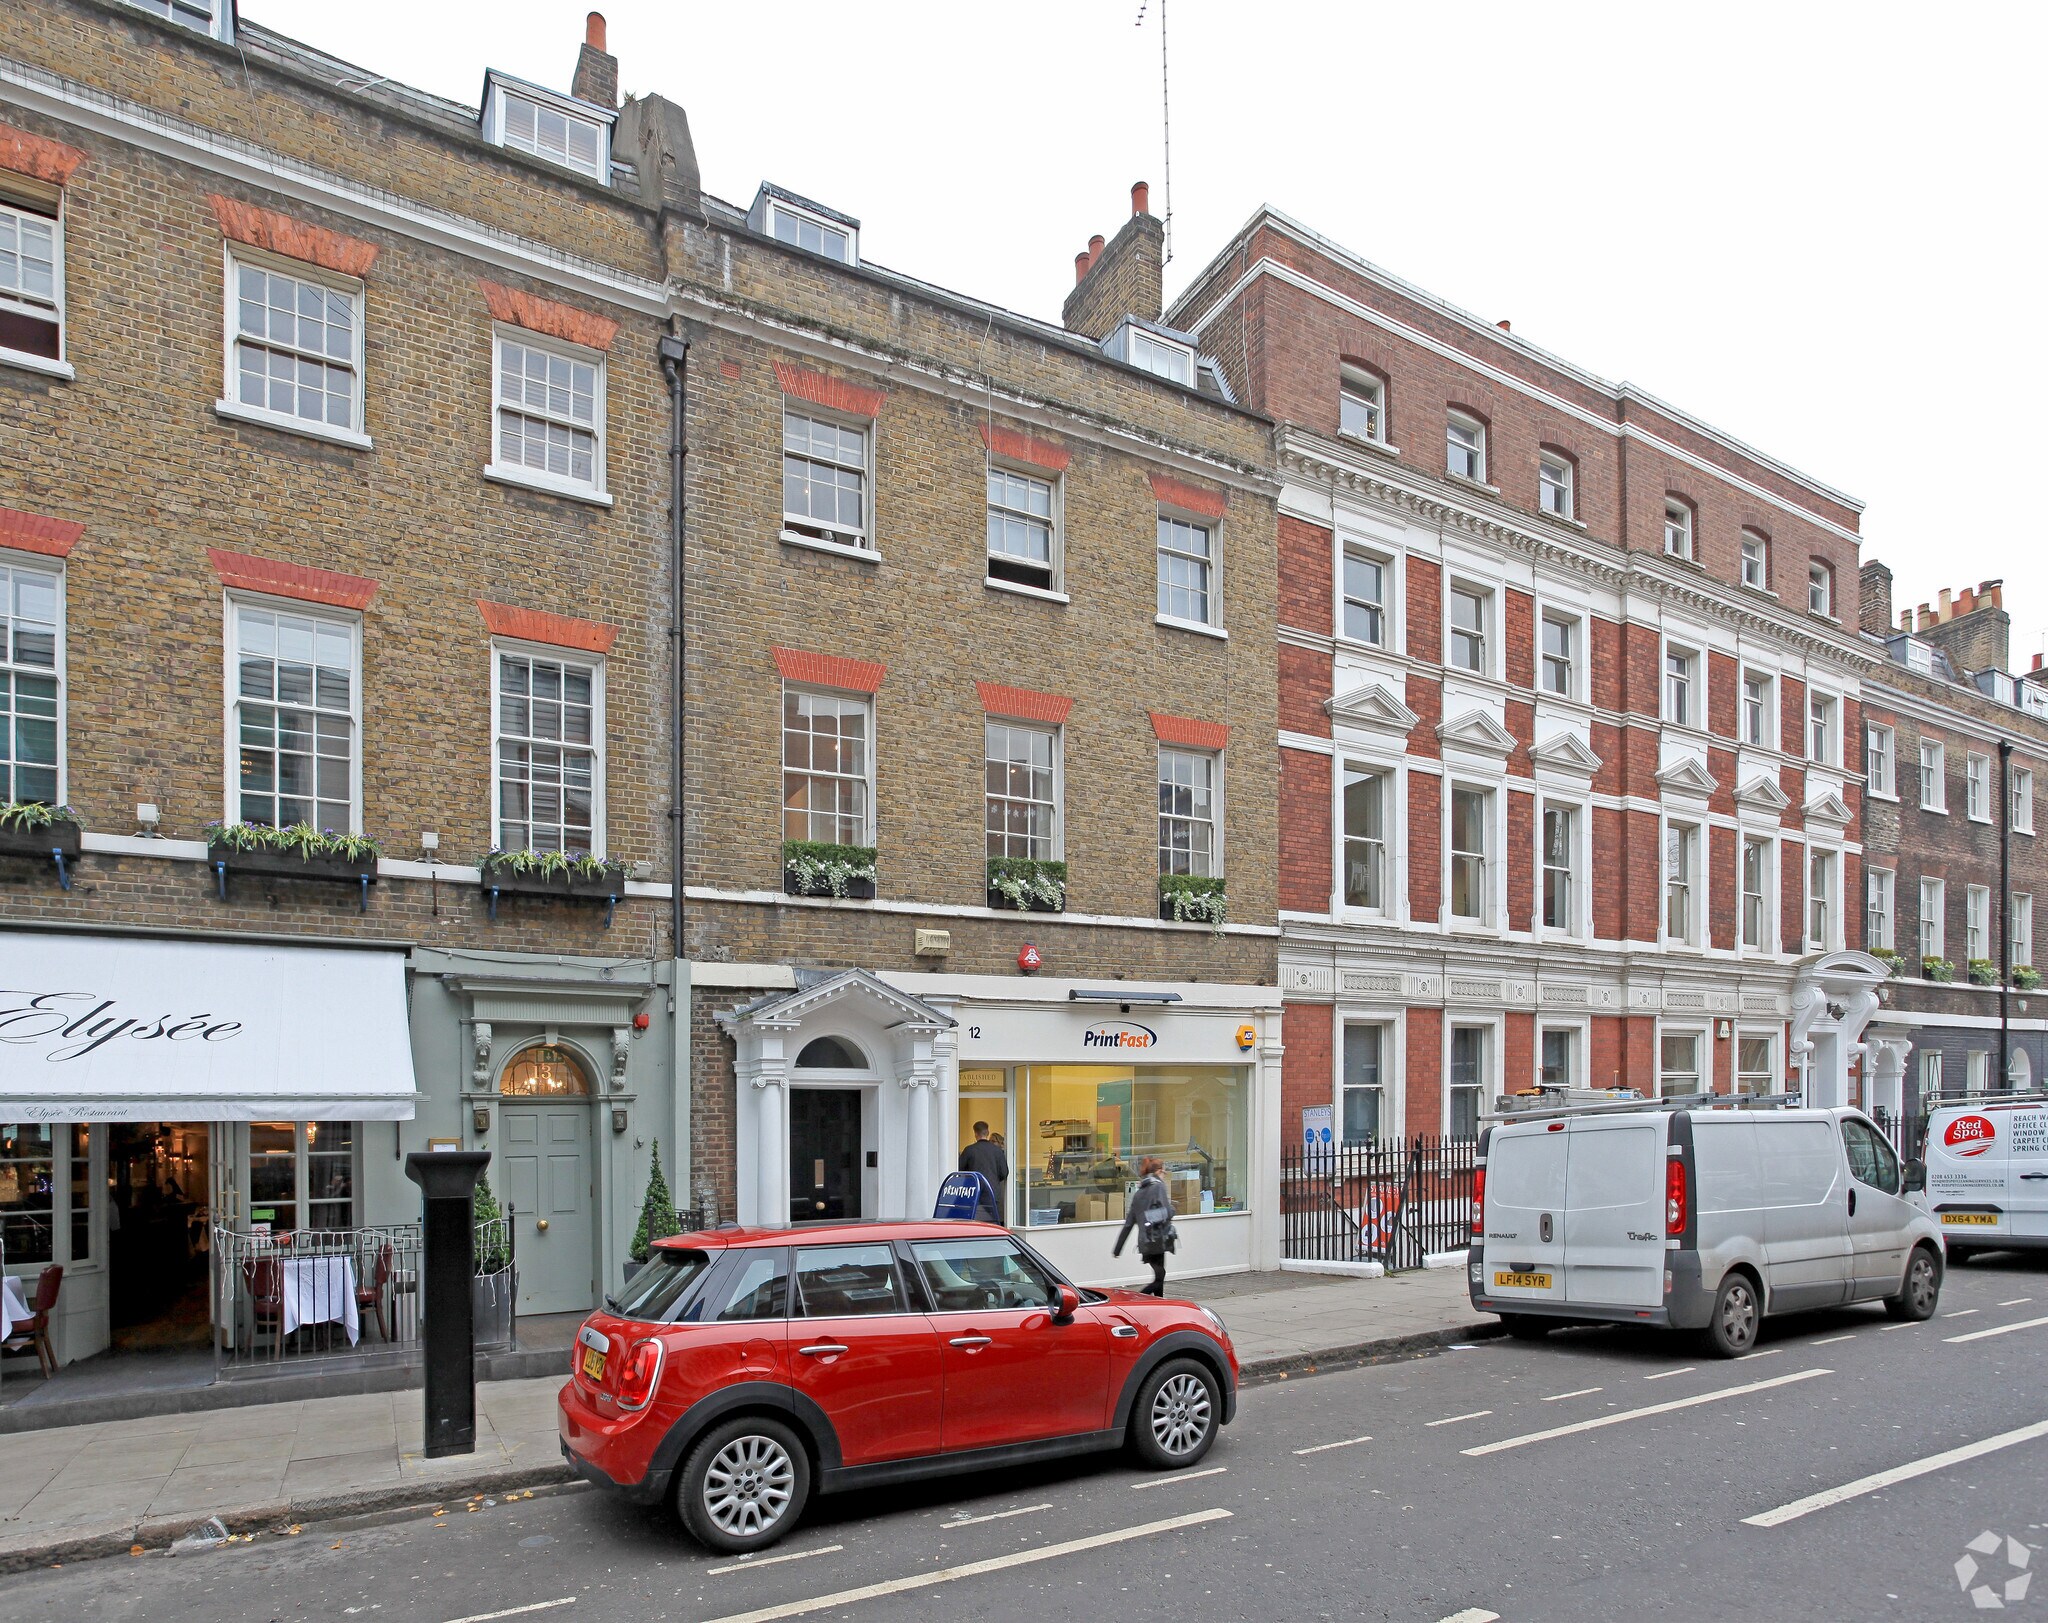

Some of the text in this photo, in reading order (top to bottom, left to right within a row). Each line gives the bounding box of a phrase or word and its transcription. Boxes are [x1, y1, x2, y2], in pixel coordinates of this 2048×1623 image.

[0, 990, 243, 1062] Elysée
[968, 1026, 981, 1039] 12
[1083, 1029, 1149, 1048] PrintFast
[533, 1064, 552, 1079] 13
[25, 1106, 128, 1122] Elysée Restaurant
[1955, 1120, 1981, 1130] Red
[1952, 1129, 1984, 1140] Spot
[943, 1185, 976, 1198] PRINTFAST
[1945, 1215, 1993, 1223] DX64 YMA
[1500, 1274, 1545, 1287] LF14 SYR
